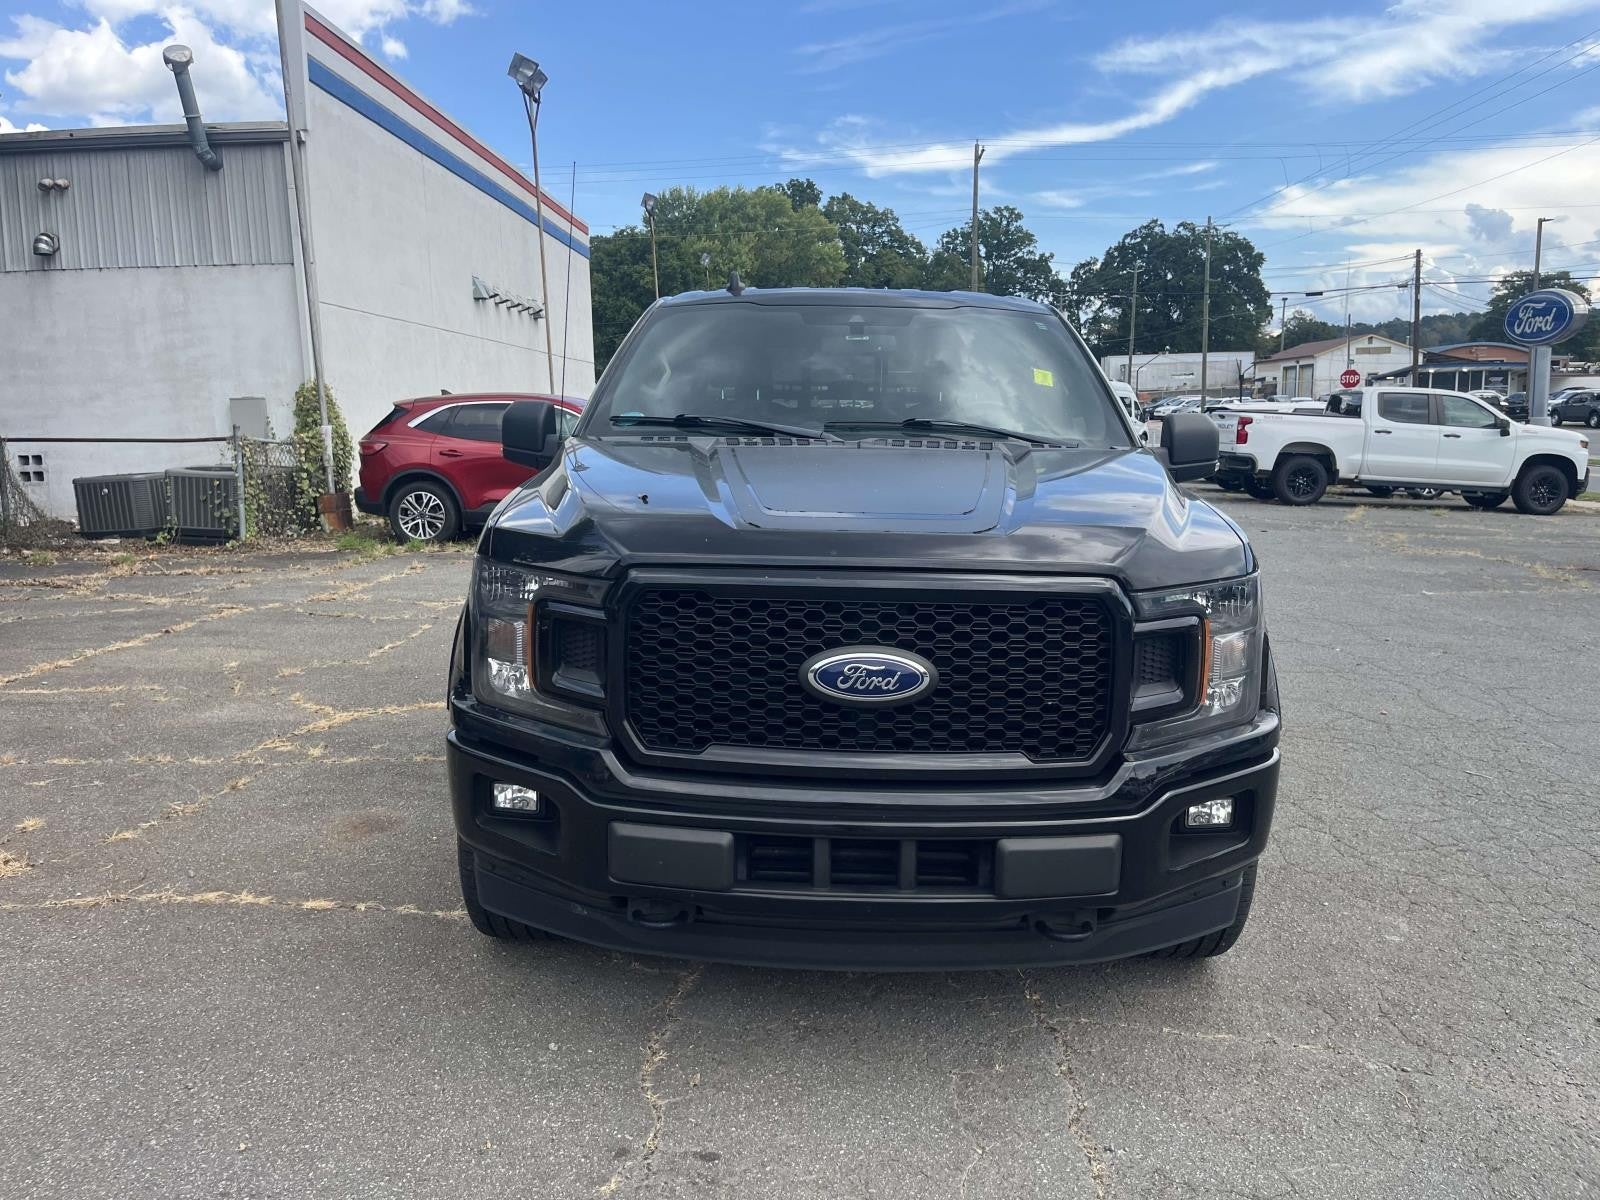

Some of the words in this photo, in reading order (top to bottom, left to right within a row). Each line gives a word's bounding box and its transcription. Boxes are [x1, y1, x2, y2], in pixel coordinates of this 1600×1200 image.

[1514, 302, 1557, 334] Ford
[1341, 375, 1360, 384] STOP
[836, 664, 902, 691] Ford
